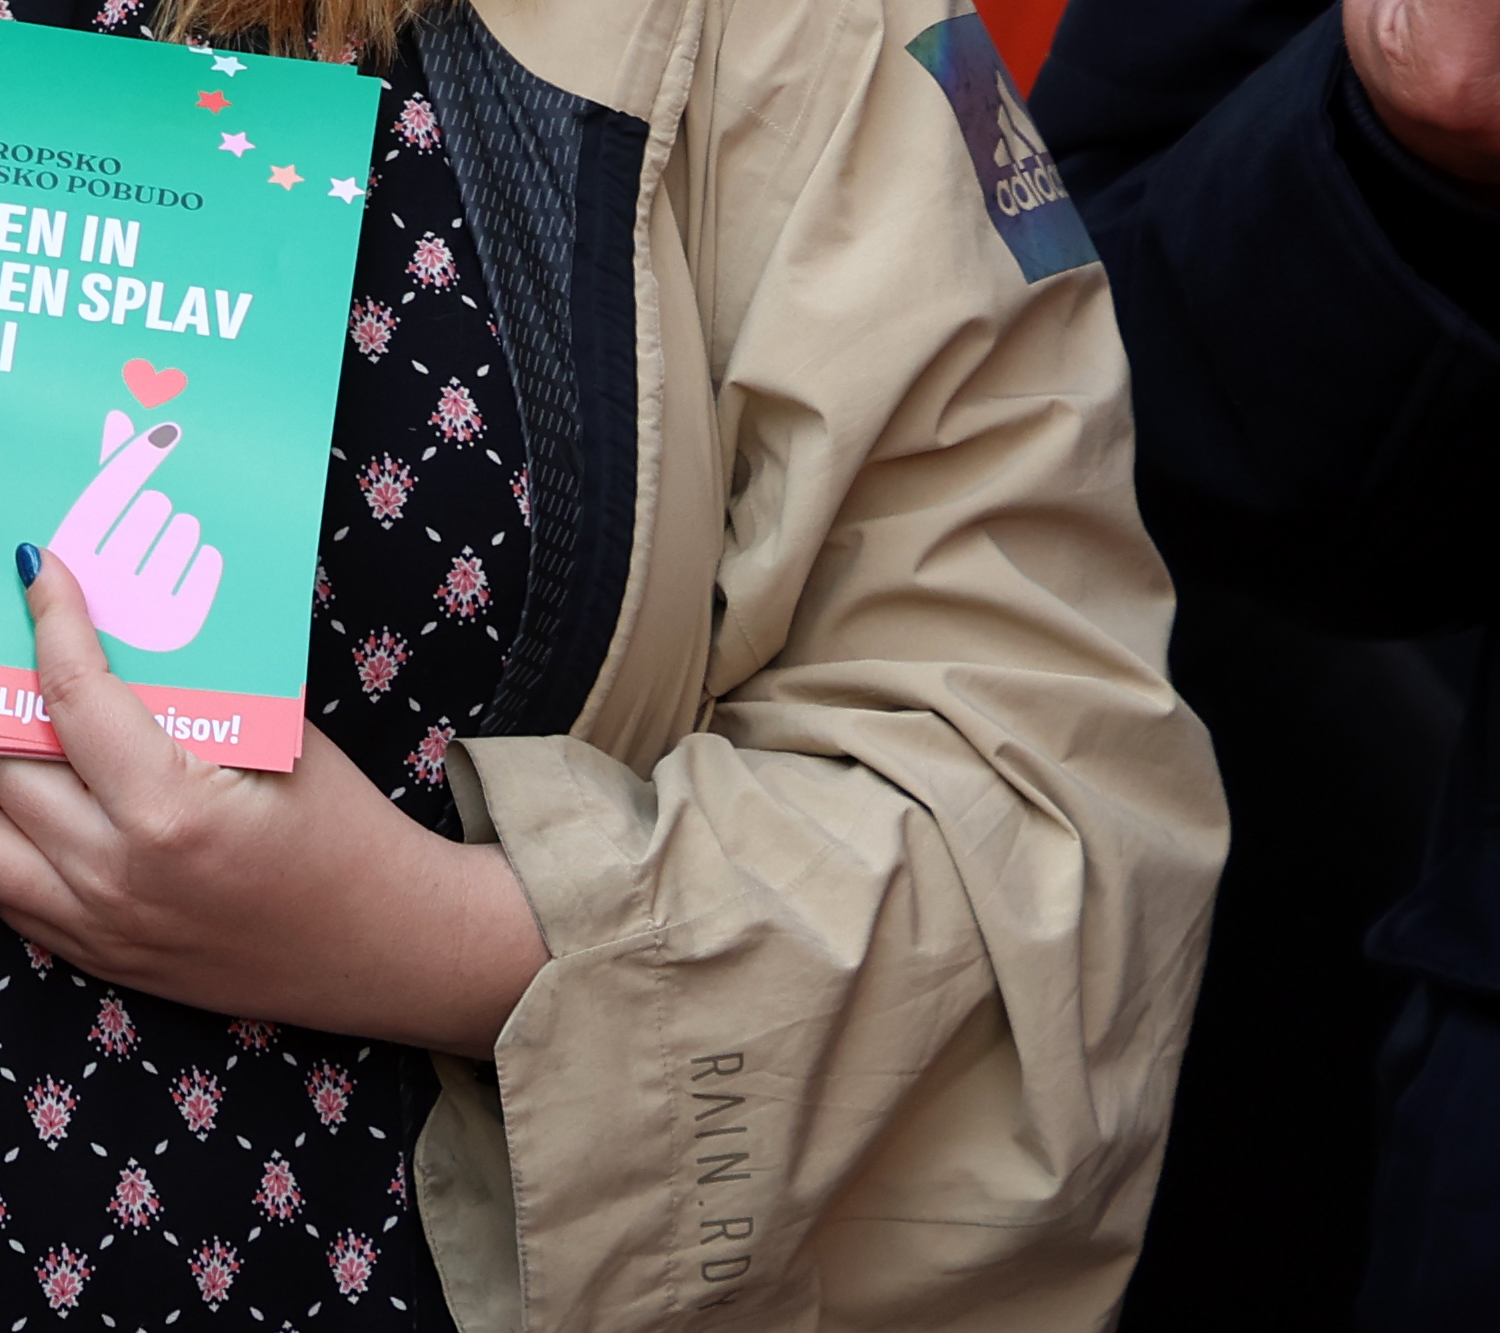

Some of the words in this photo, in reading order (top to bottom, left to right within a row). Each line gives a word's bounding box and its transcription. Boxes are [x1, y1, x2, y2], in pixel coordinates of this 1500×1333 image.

[66, 171, 205, 211] POBUDO
[79, 215, 141, 268] IN
[78, 274, 253, 340] SPLAV
